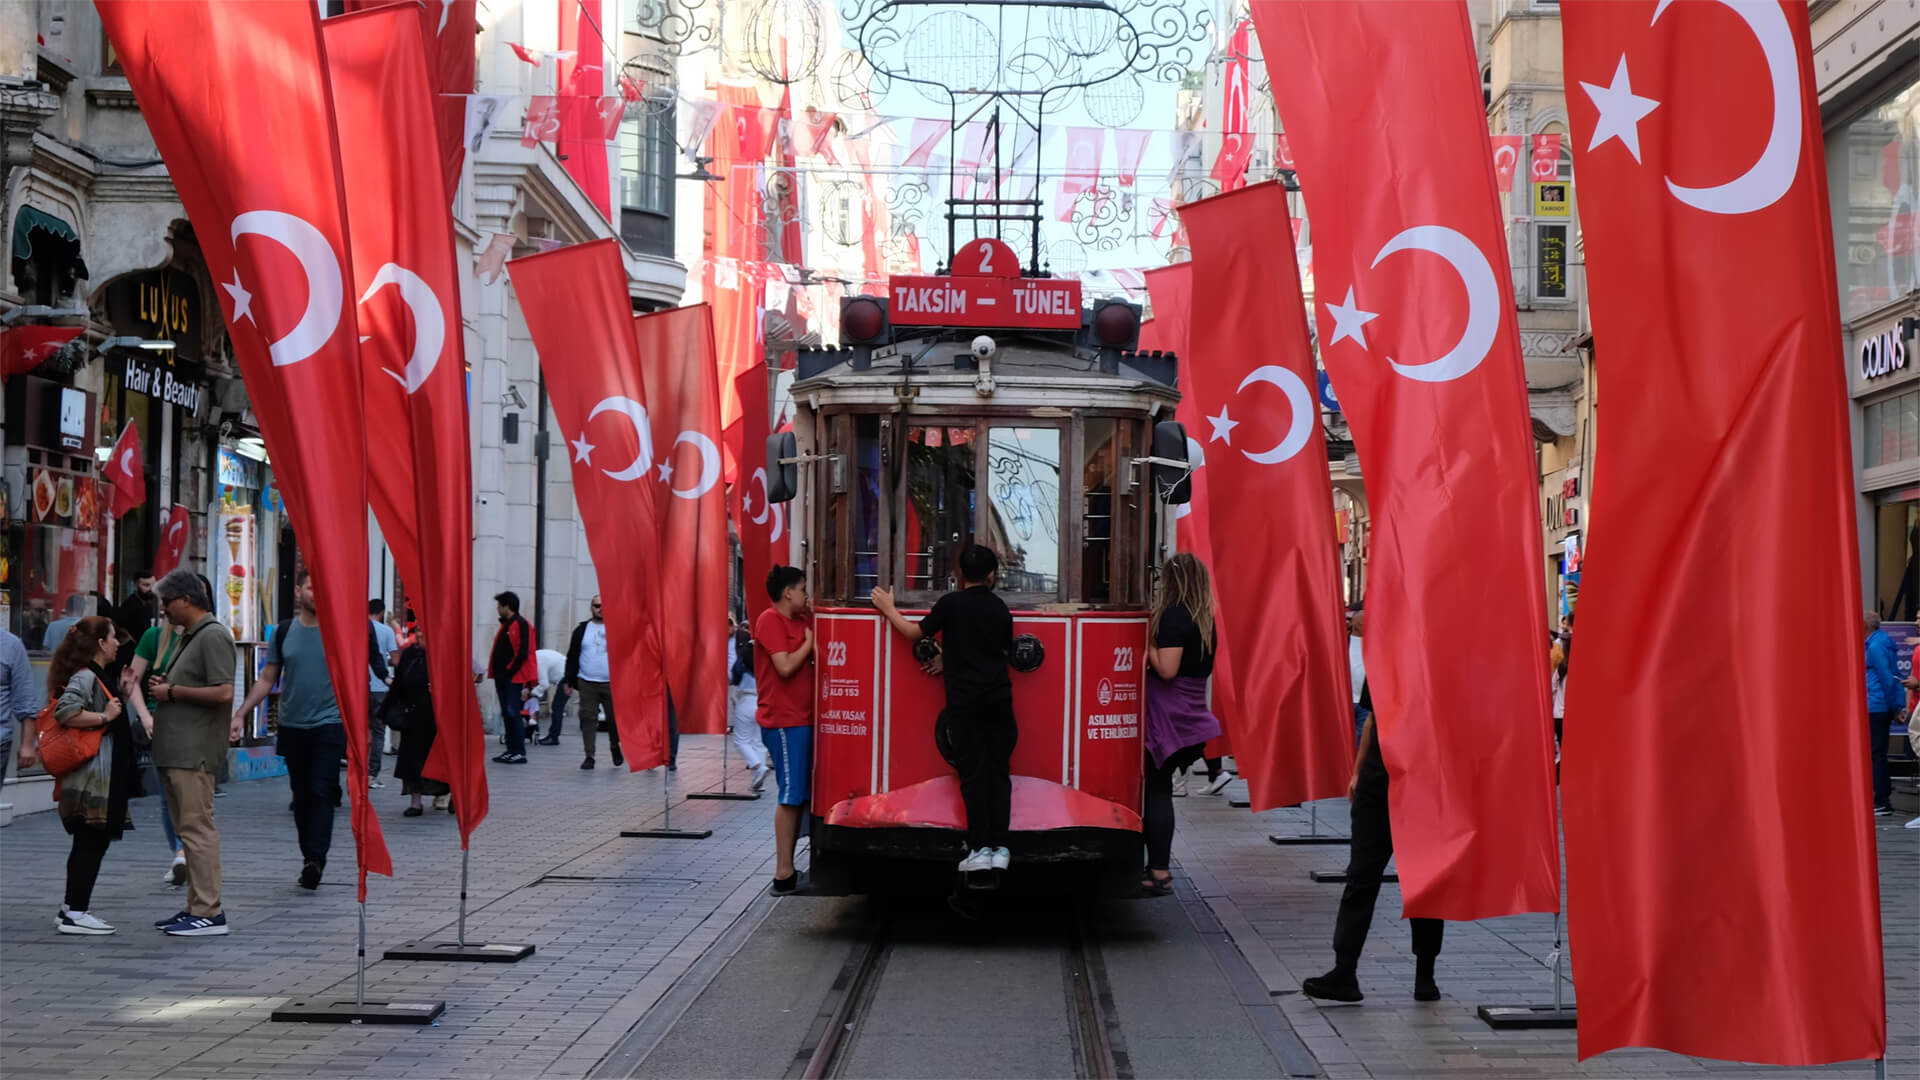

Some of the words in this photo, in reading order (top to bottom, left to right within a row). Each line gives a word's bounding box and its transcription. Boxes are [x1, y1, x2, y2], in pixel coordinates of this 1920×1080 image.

[979, 243, 993, 273] 2
[895, 282, 967, 315] TAKSİM
[1013, 284, 1076, 316] TÜNEL
[125, 358, 150, 393] Hair
[152, 367, 161, 398] &
[163, 371, 200, 418] Beauty
[827, 641, 847, 667] 223
[1113, 647, 1133, 672] 223
[841, 710, 866, 721] YASAK
[1087, 728, 1099, 740] VE
